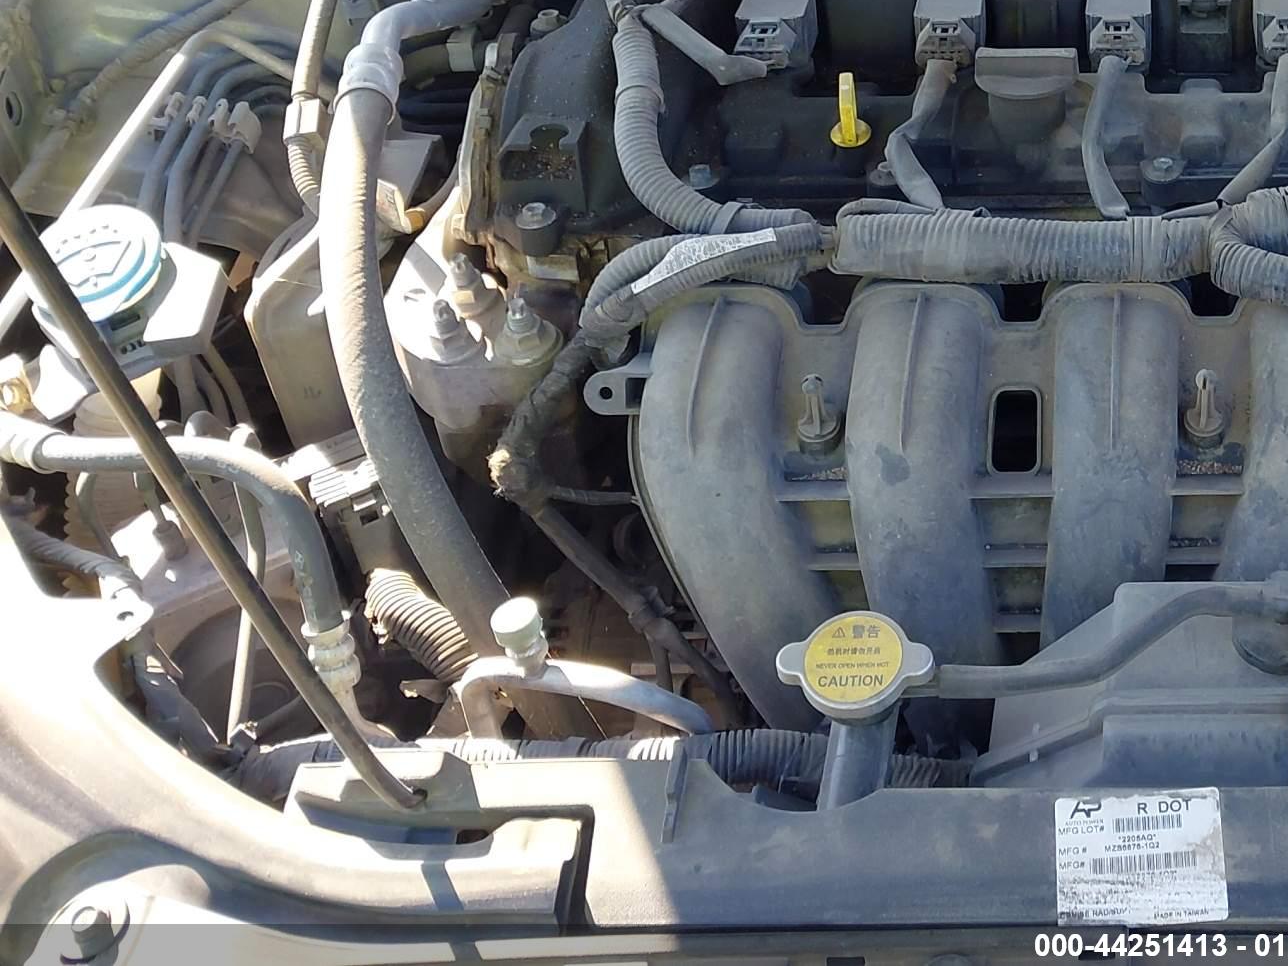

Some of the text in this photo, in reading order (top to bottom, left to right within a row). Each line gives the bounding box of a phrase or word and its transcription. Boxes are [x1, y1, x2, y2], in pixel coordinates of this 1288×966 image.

[838, 661, 856, 669] OPEN
[856, 661, 876, 669] WHEN
[818, 674, 884, 687] CAUTION
[1137, 799, 1192, 815] R DOT
